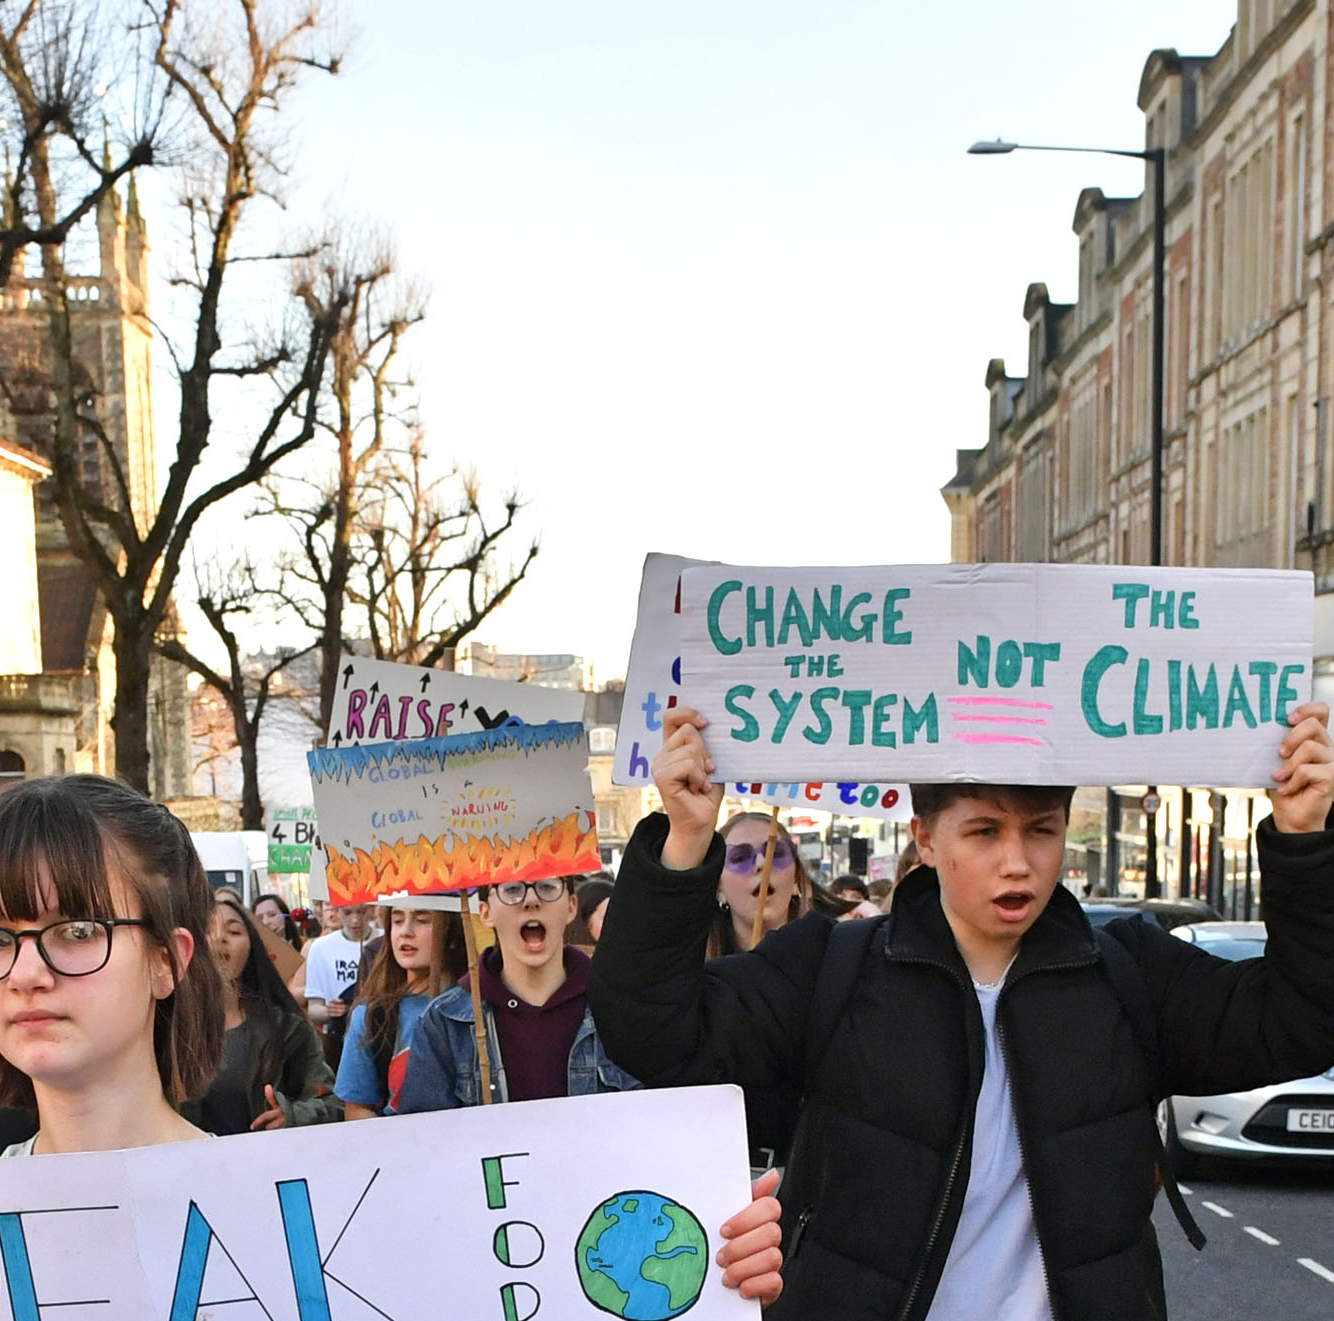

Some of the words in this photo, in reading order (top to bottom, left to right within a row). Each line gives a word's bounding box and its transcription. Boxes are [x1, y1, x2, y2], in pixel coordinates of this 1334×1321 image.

[707, 580, 913, 655] CHANGE
[1112, 583, 1200, 629] THE
[784, 654, 844, 678] THE
[957, 635, 1061, 689] NOT
[346, 688, 456, 740] RAISE
[724, 684, 939, 749] SYSTEM
[1080, 645, 1306, 738] CLIMATE
[272, 823, 287, 844] 4
[335, 960, 360, 971] IRO
